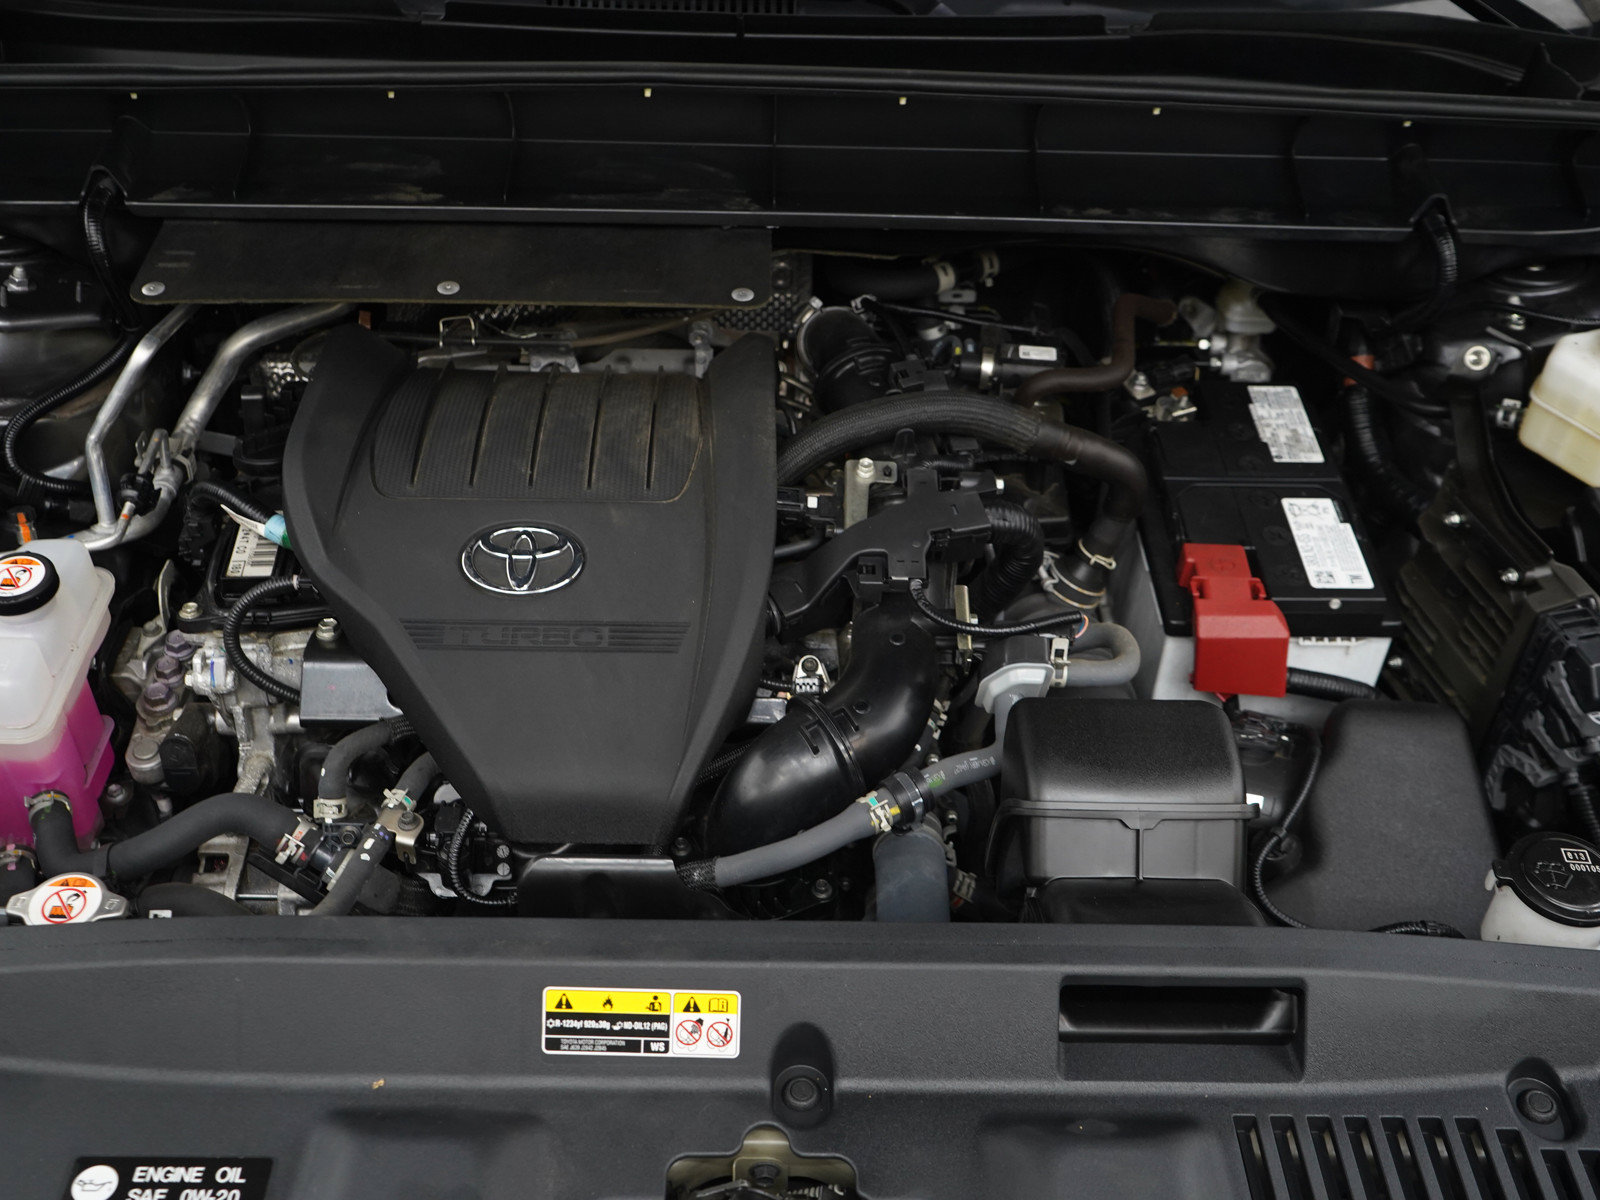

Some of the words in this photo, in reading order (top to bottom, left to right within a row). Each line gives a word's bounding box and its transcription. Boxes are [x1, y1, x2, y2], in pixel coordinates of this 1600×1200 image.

[450, 626, 604, 646] TURBO
[578, 1038, 595, 1046] MOTOR
[595, 1039, 626, 1047] CORPORATION
[650, 1041, 666, 1052] WS
[132, 1166, 206, 1183] ENGINE
[215, 1166, 247, 1183] OIL
